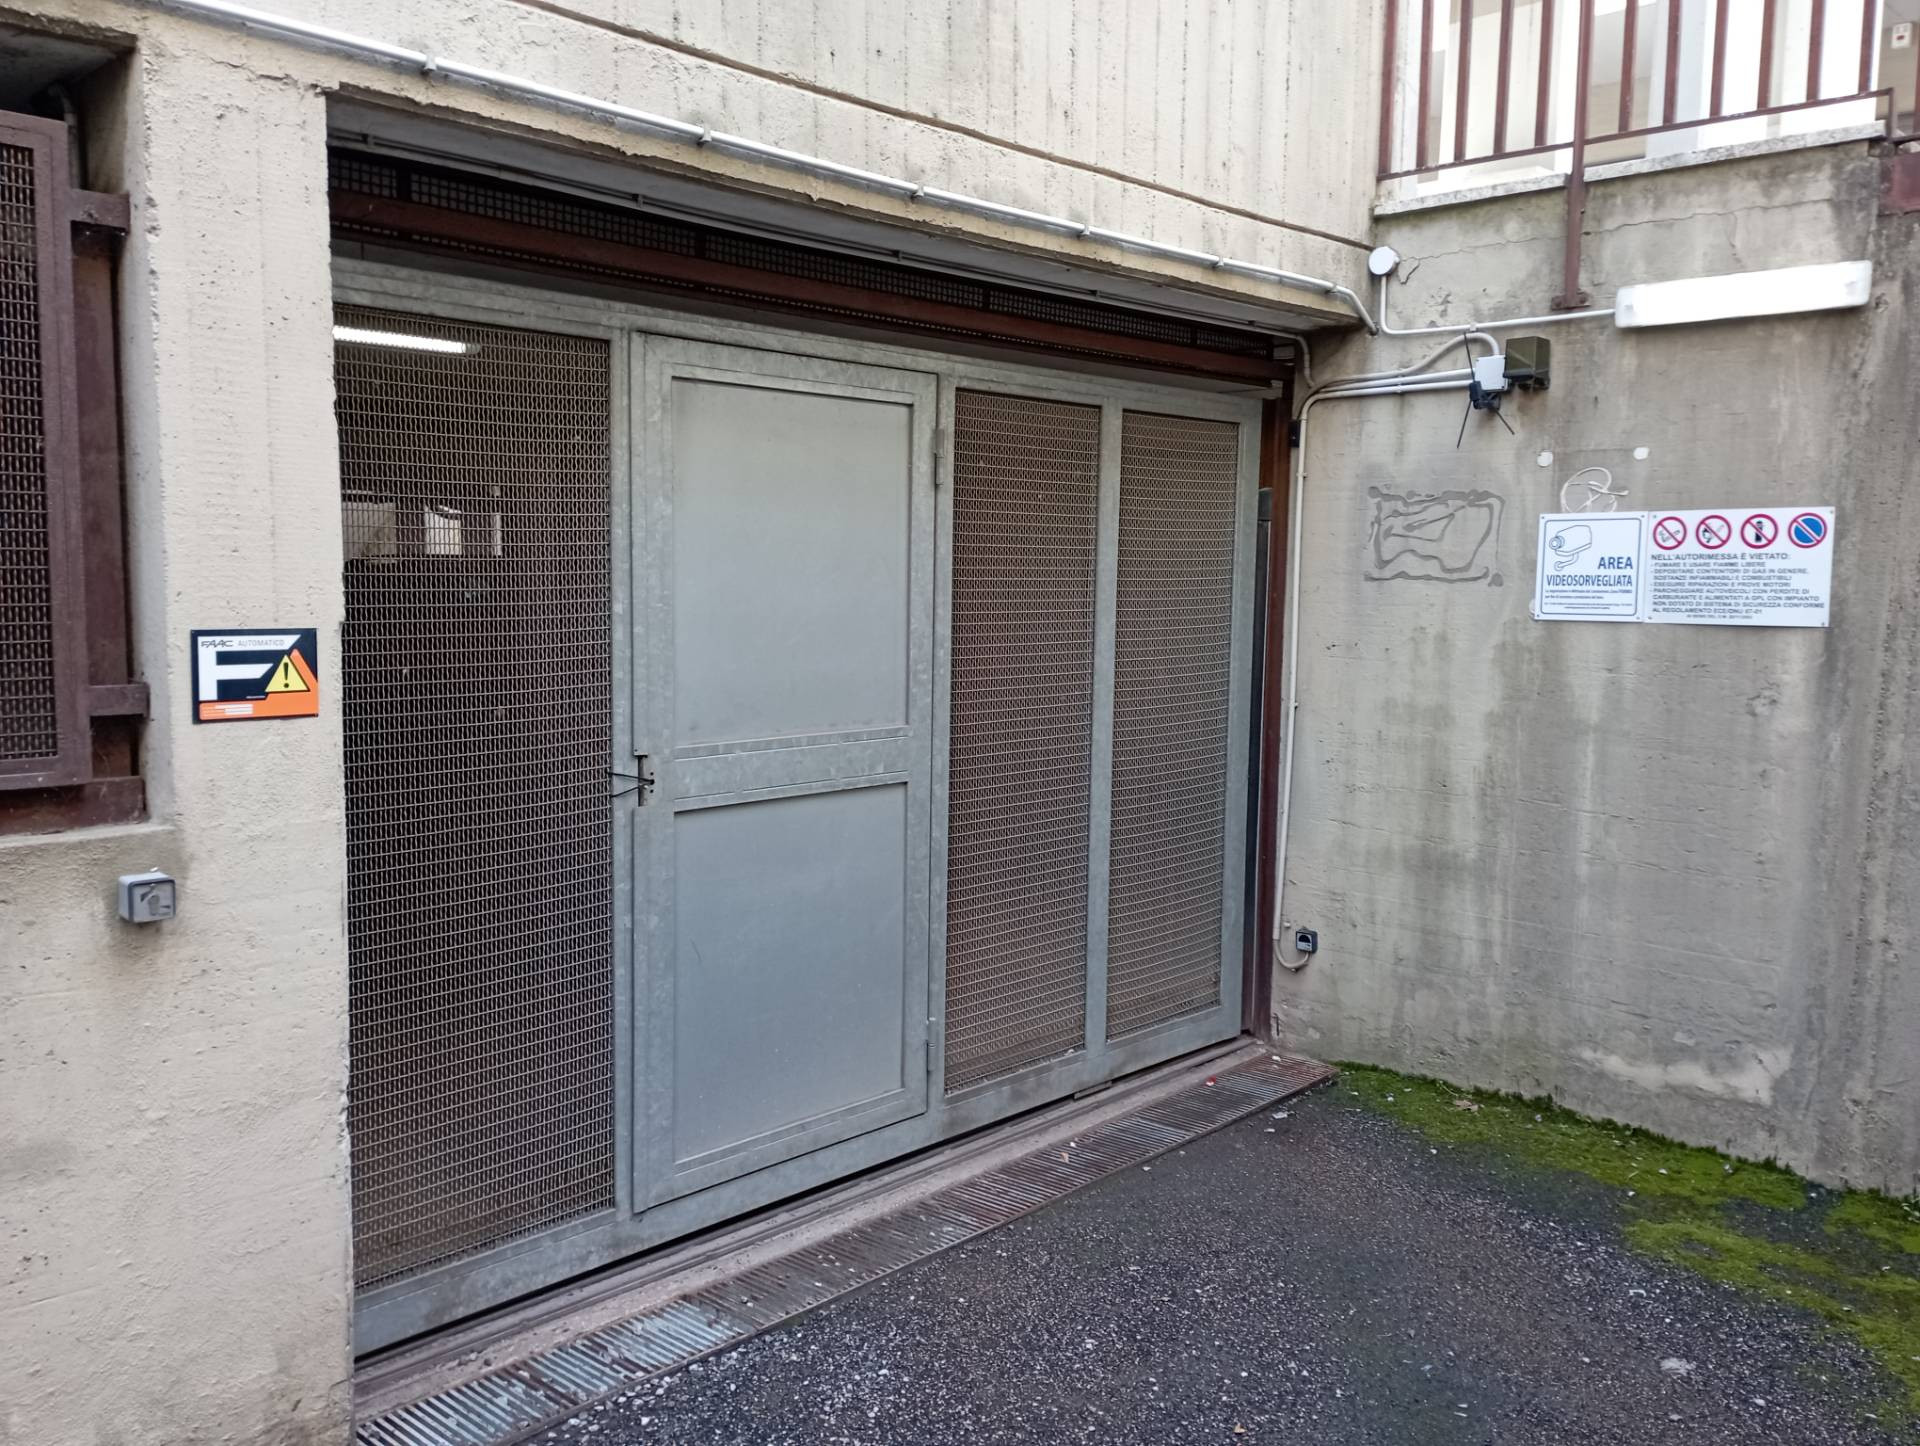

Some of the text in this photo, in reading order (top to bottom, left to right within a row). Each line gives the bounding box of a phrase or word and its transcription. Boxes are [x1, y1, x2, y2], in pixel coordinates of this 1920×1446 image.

[1598, 556, 1633, 570] AREA
[1546, 574, 1632, 587] VIDEOSORVEGLIATA
[201, 640, 234, 648] FAAC
